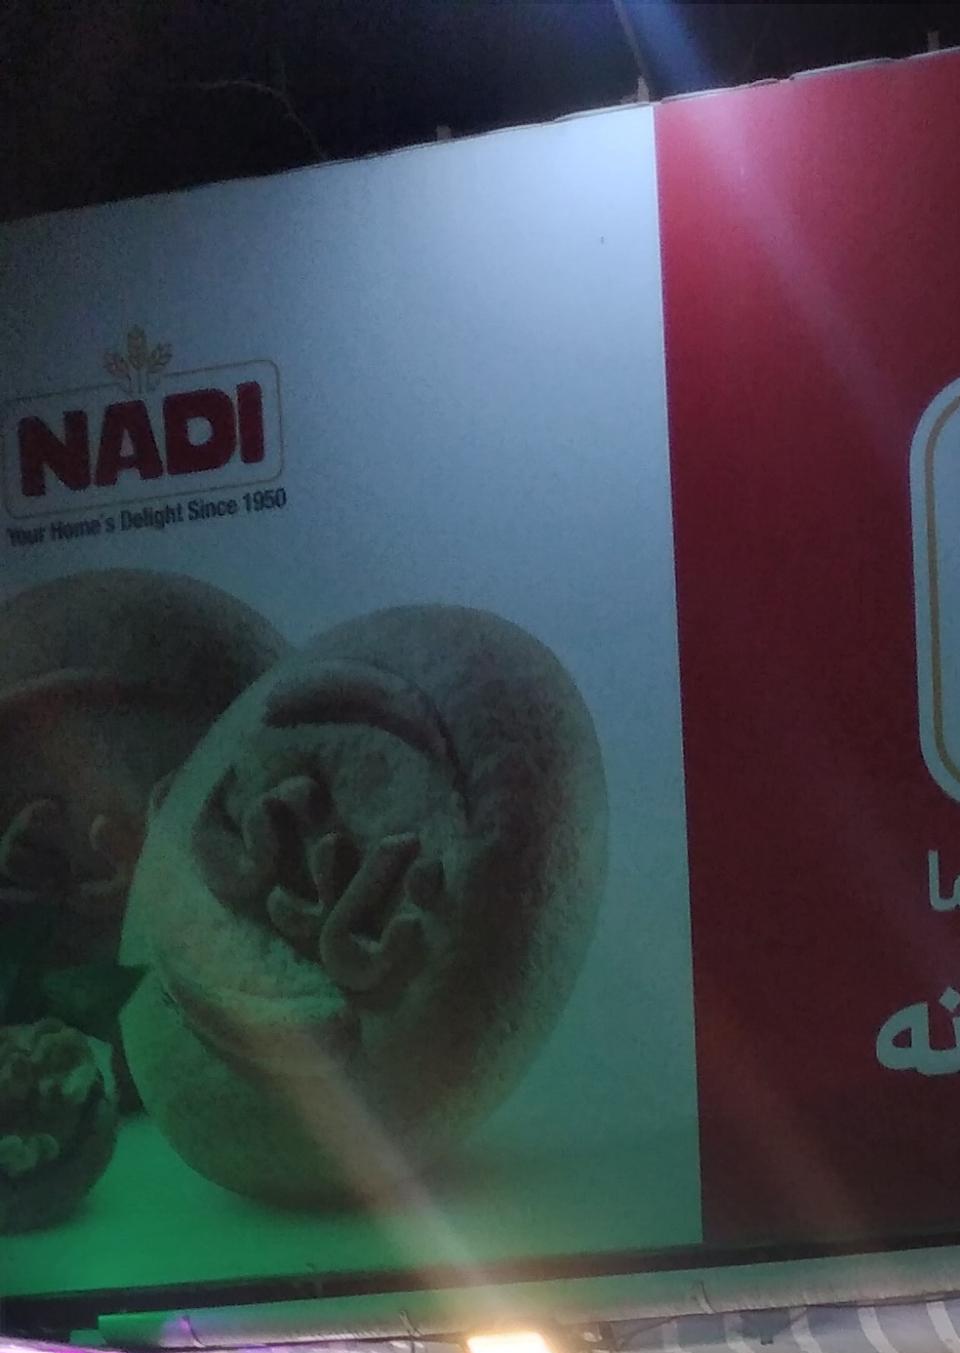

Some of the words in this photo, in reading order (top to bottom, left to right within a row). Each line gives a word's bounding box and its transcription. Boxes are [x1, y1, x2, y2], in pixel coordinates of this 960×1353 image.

[17, 381, 265, 497] NADI
[7, 526, 46, 547] Your
[120, 503, 183, 530] Delight
[188, 497, 237, 520] Since
[242, 487, 287, 510] 1950
